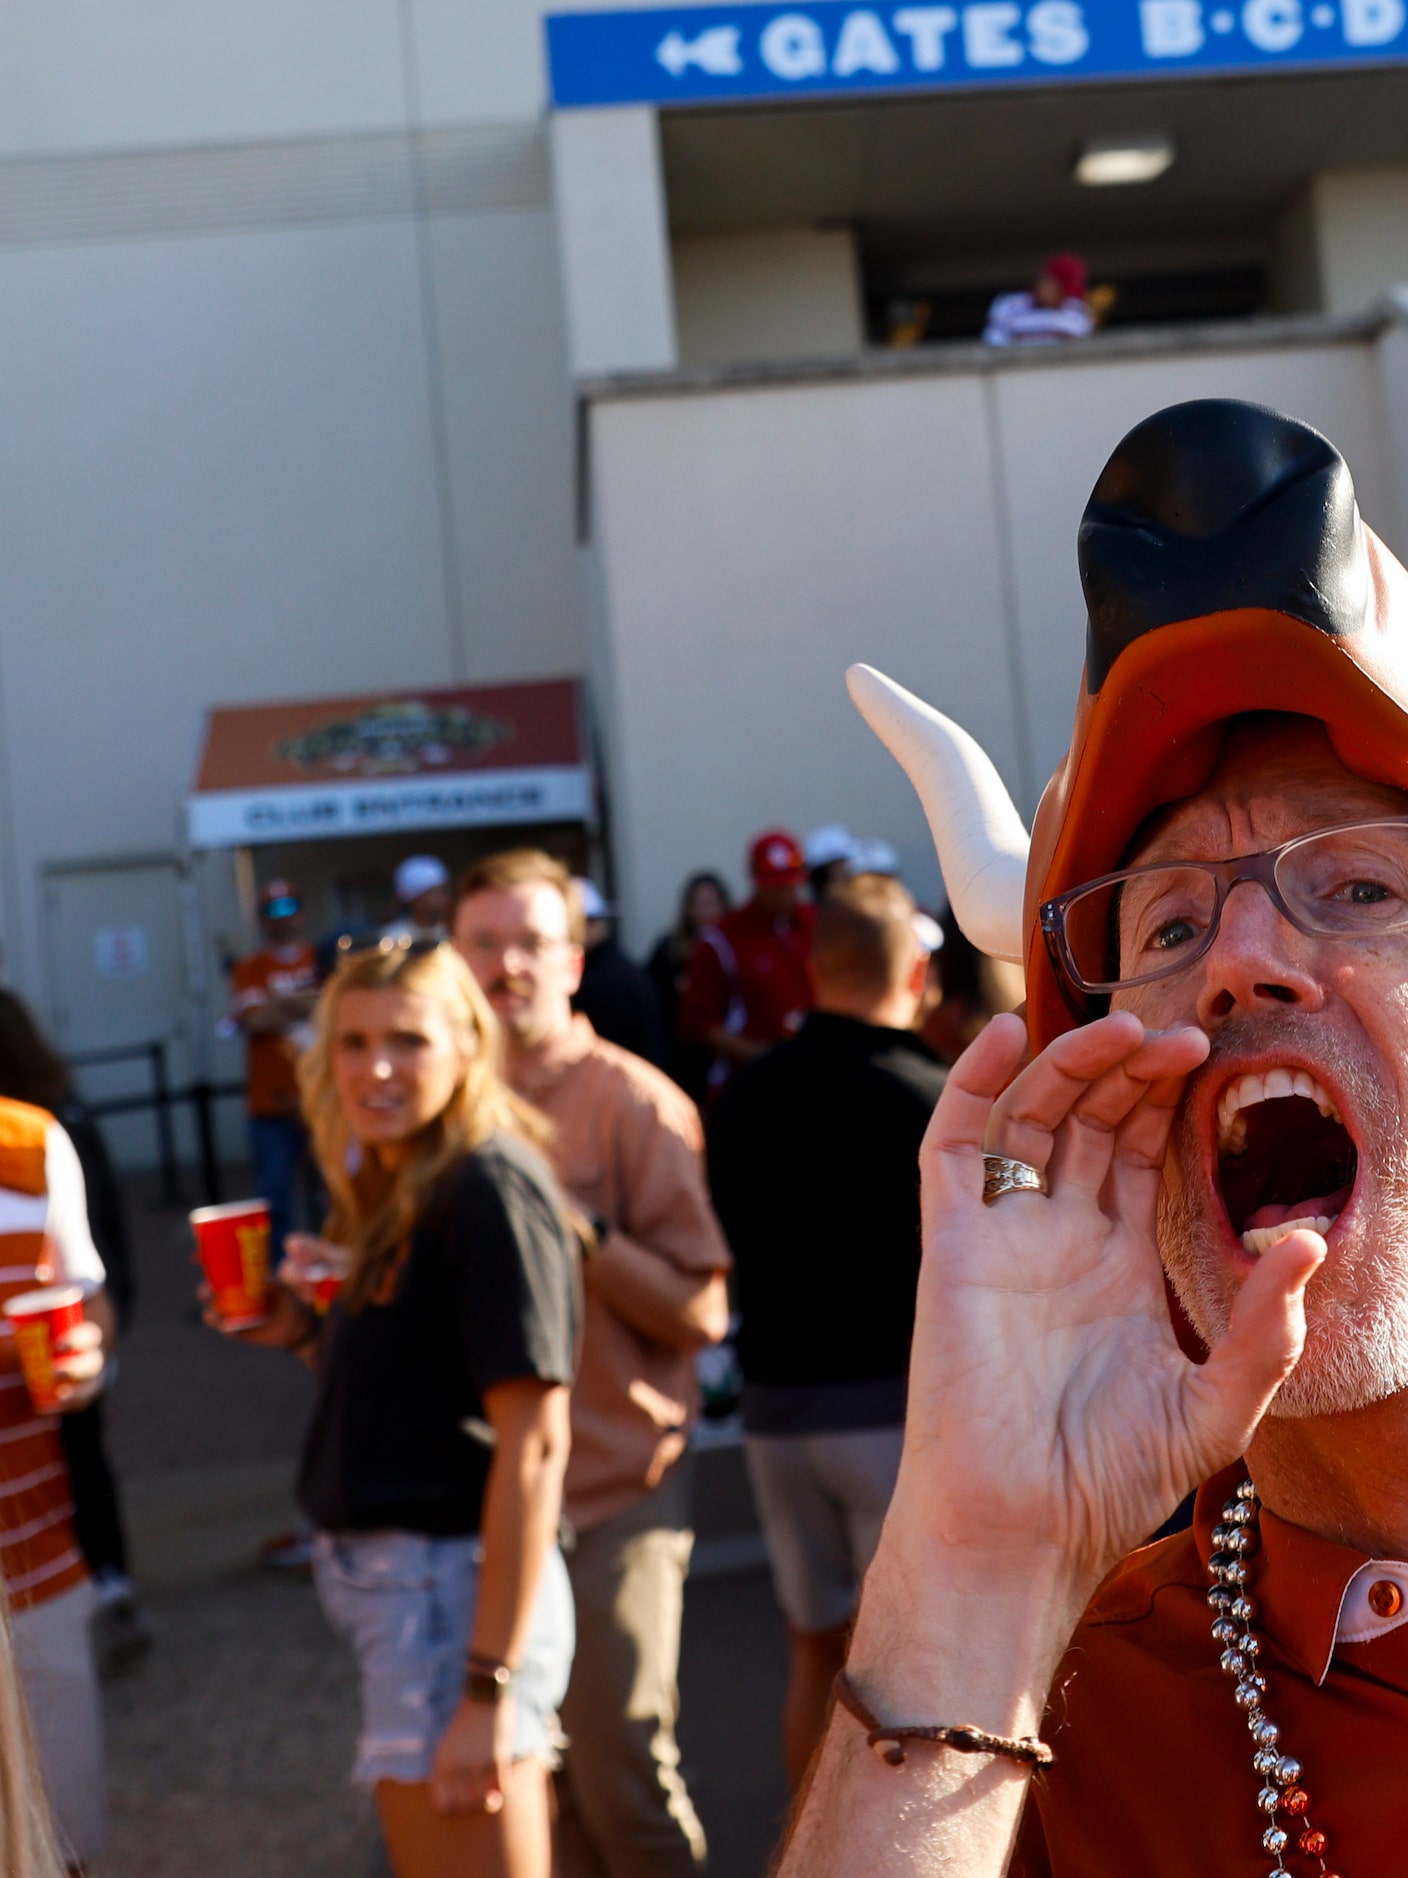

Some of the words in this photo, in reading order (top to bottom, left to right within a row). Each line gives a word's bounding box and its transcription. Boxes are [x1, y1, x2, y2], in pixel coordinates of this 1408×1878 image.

[759, 0, 1090, 80] GATES
[244, 798, 340, 830] CLUB
[350, 784, 545, 822] ENTRANCE
